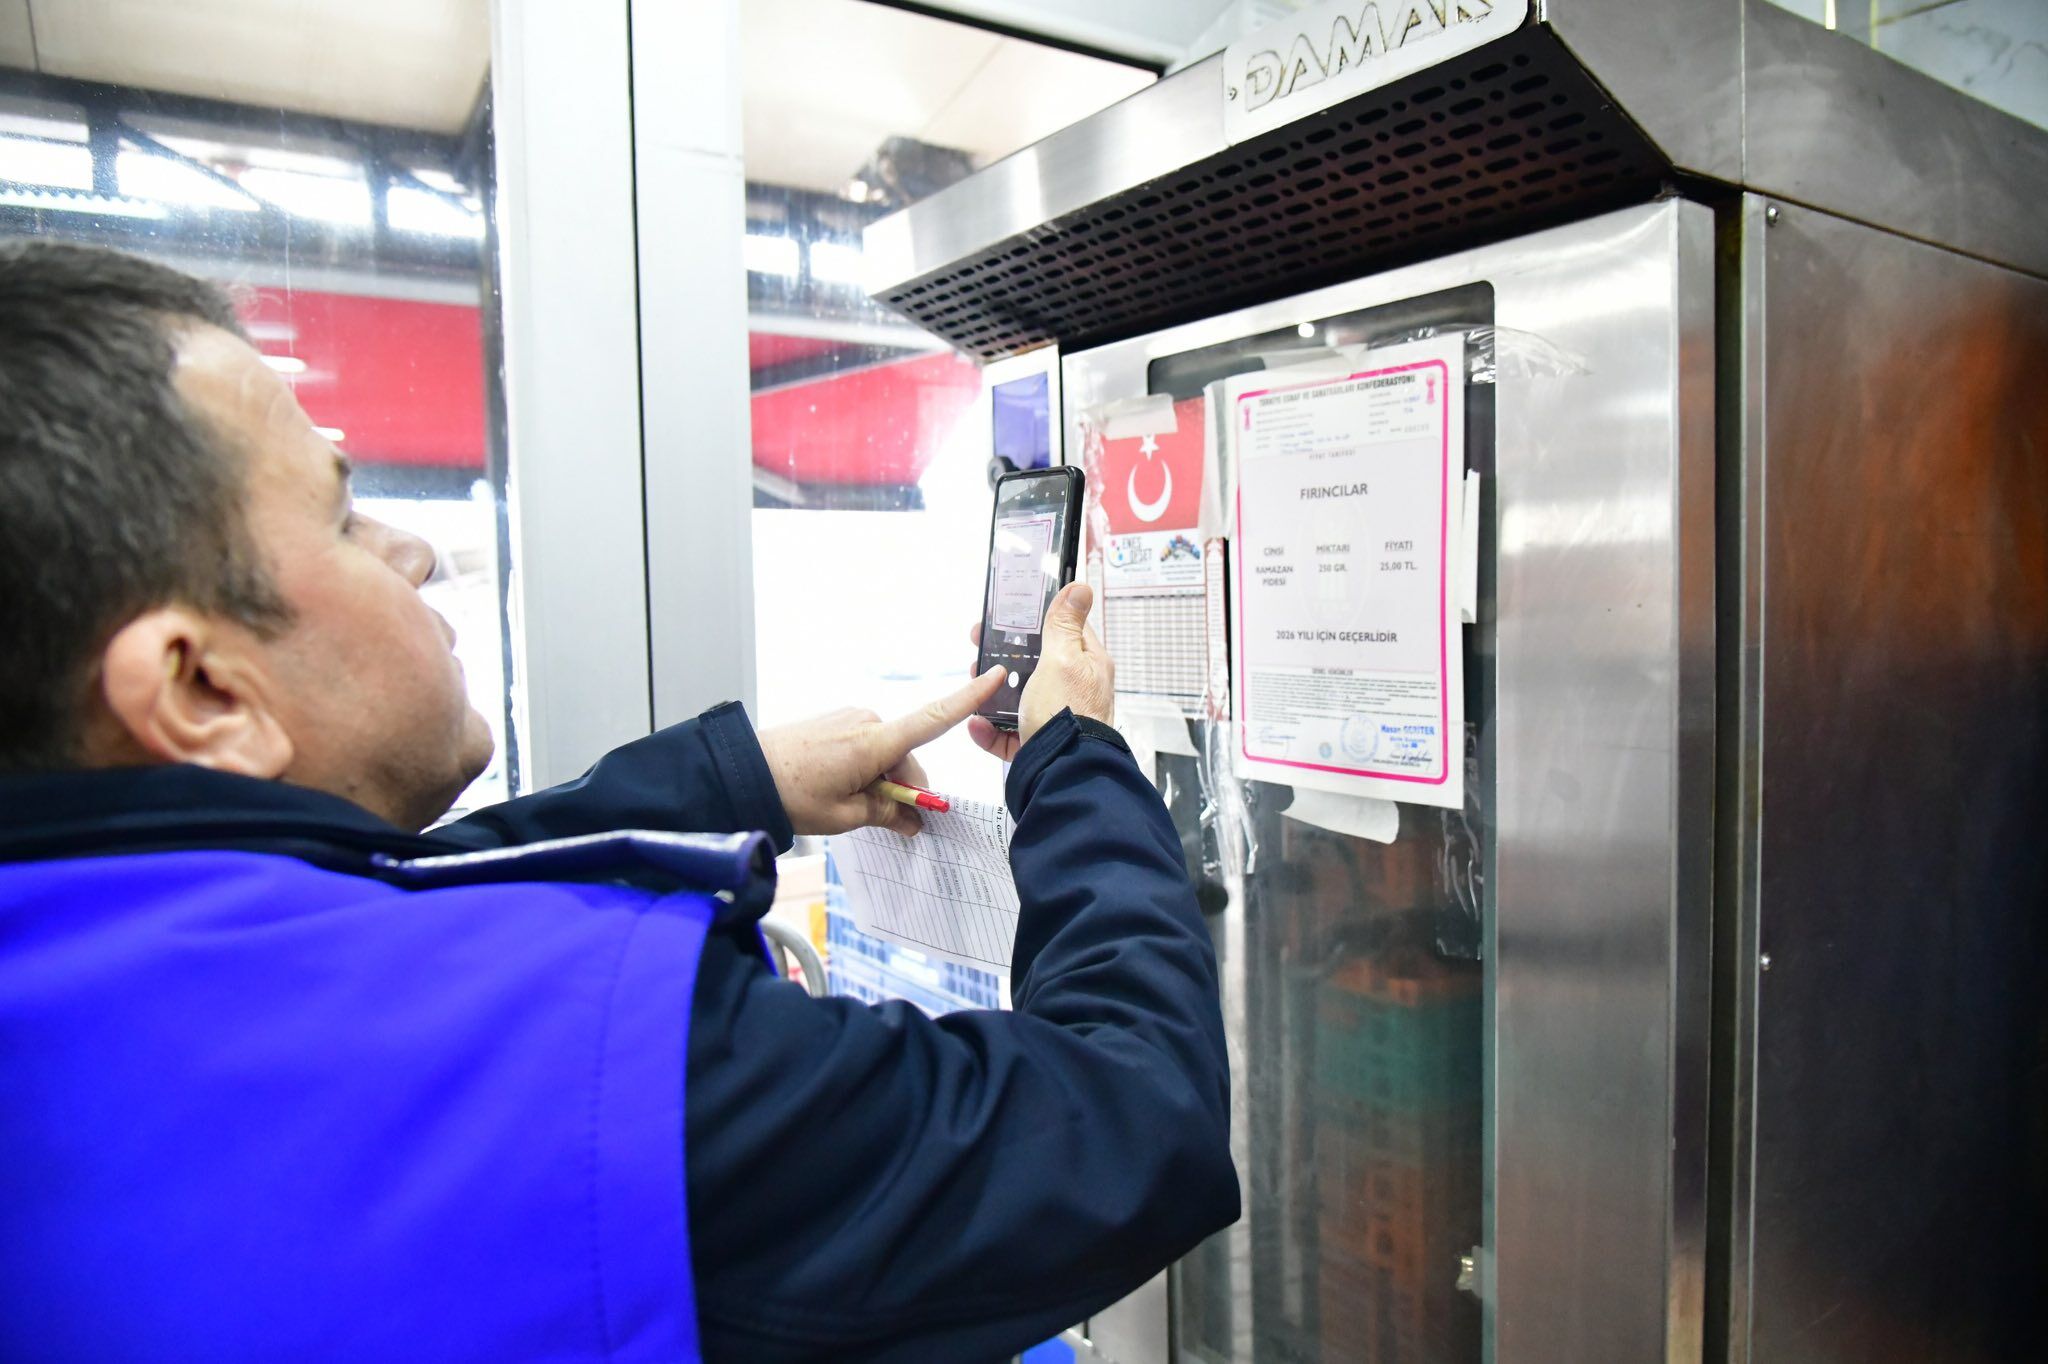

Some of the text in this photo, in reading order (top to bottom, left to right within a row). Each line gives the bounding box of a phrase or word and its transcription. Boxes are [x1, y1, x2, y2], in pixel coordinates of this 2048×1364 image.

[1300, 482, 1368, 500] FIRINCILAR
[1385, 539, 1413, 551] FİYATI
[1255, 564, 1293, 575] RAMAZAN
[1318, 563, 1332, 573] 250
[1403, 560, 1418, 571] TL.
[1276, 630, 1398, 643] 2026 YILI İÇİN GEÇERLİDİR
